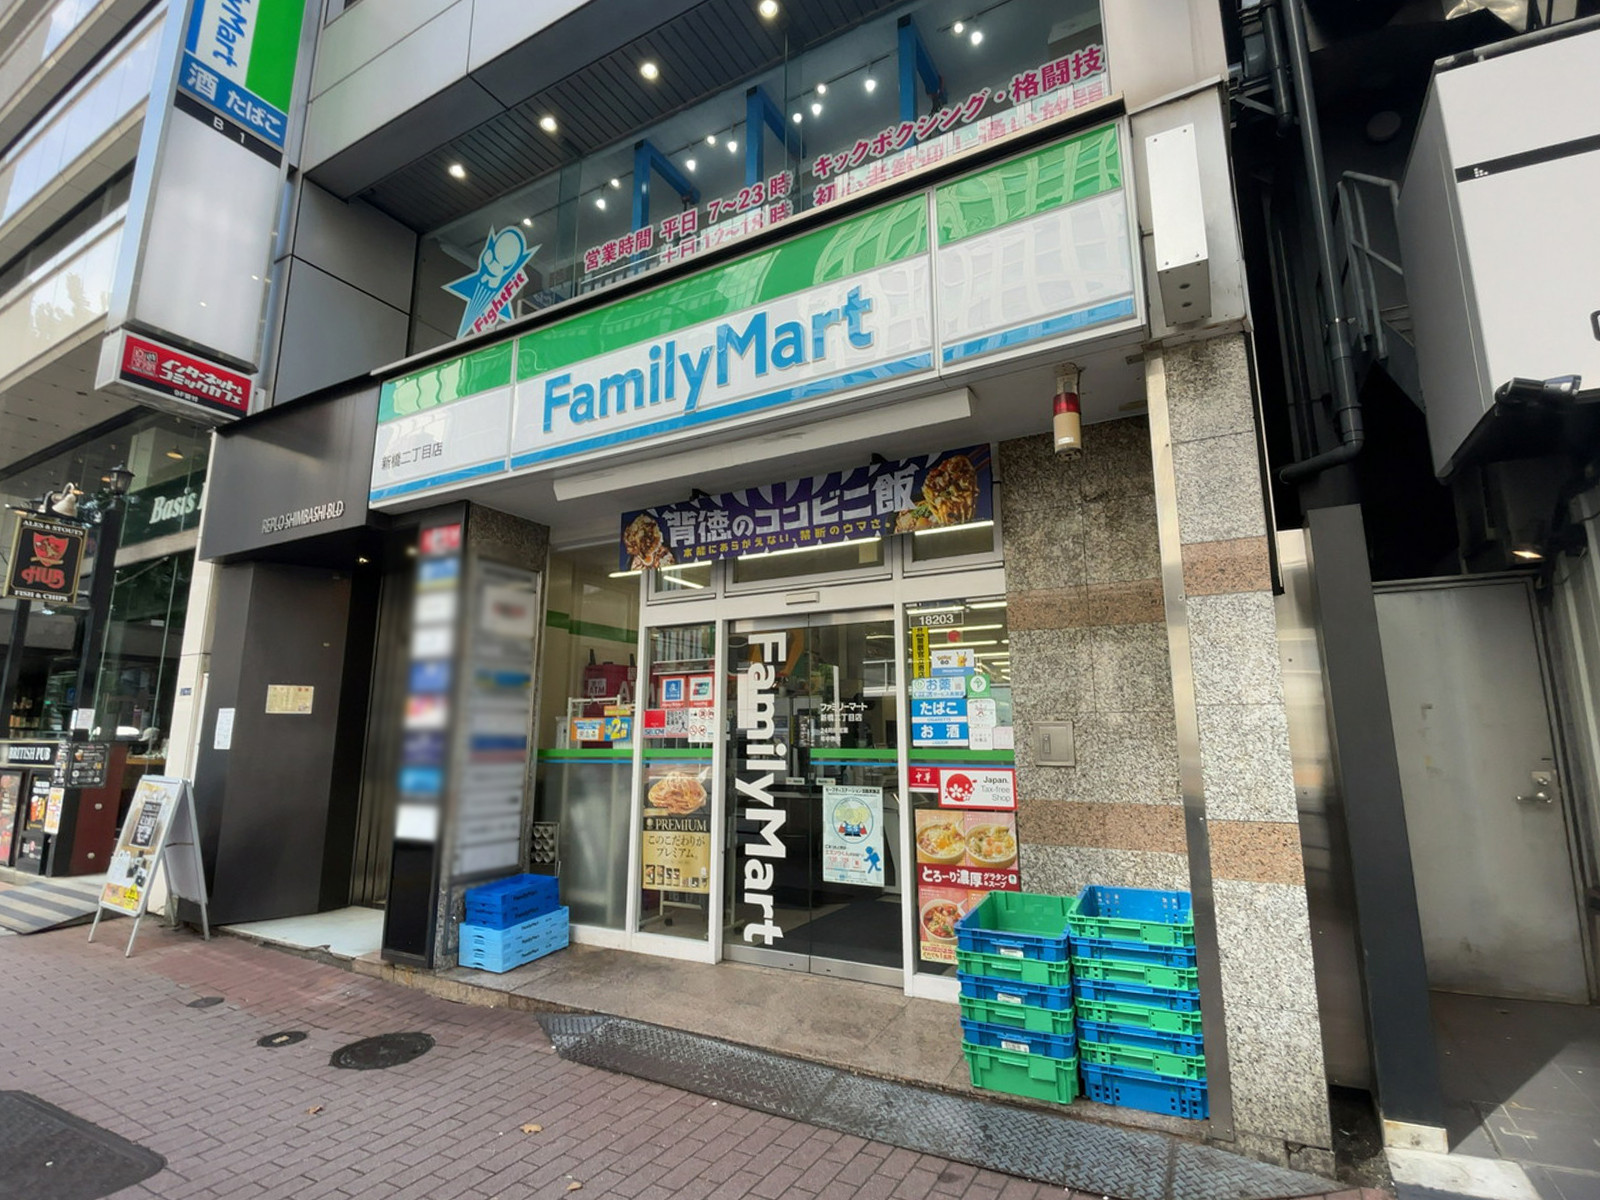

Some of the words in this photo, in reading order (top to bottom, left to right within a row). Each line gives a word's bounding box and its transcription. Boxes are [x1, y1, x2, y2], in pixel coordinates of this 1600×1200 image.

[186, 62, 219, 101] 酒
[226, 90, 281, 138] たばこ
[812, 47, 1102, 177] キックボクシング・格闘技
[585, 228, 653, 271] 営業時間
[660, 208, 698, 241] 平日
[473, 272, 526, 333] FightFit
[542, 285, 875, 433] FamilyMart
[382, 442, 444, 470] 新橋二丁目店
[660, 468, 917, 549] 背徳のコンビニ飯
[23, 520, 44, 529] ALES
[52, 524, 84, 536] STOUTS
[21, 565, 65, 589] HUB
[14, 589, 34, 598] FISH
[42, 593, 69, 602] CHIPS
[919, 613, 954, 626] 18203
[820, 702, 868, 712] ファミリーマート
[920, 701, 958, 716] たばこ
[921, 724, 959, 738] お酒
[8, 746, 36, 760] BRITISH
[35, 746, 51, 761] PUB
[735, 631, 787, 945] FamilyMart
[981, 785, 1011, 794] Tax-free
[991, 794, 1012, 803] Shop
[655, 818, 708, 832] PREMIUM
[648, 835, 706, 847] このこだわりが
